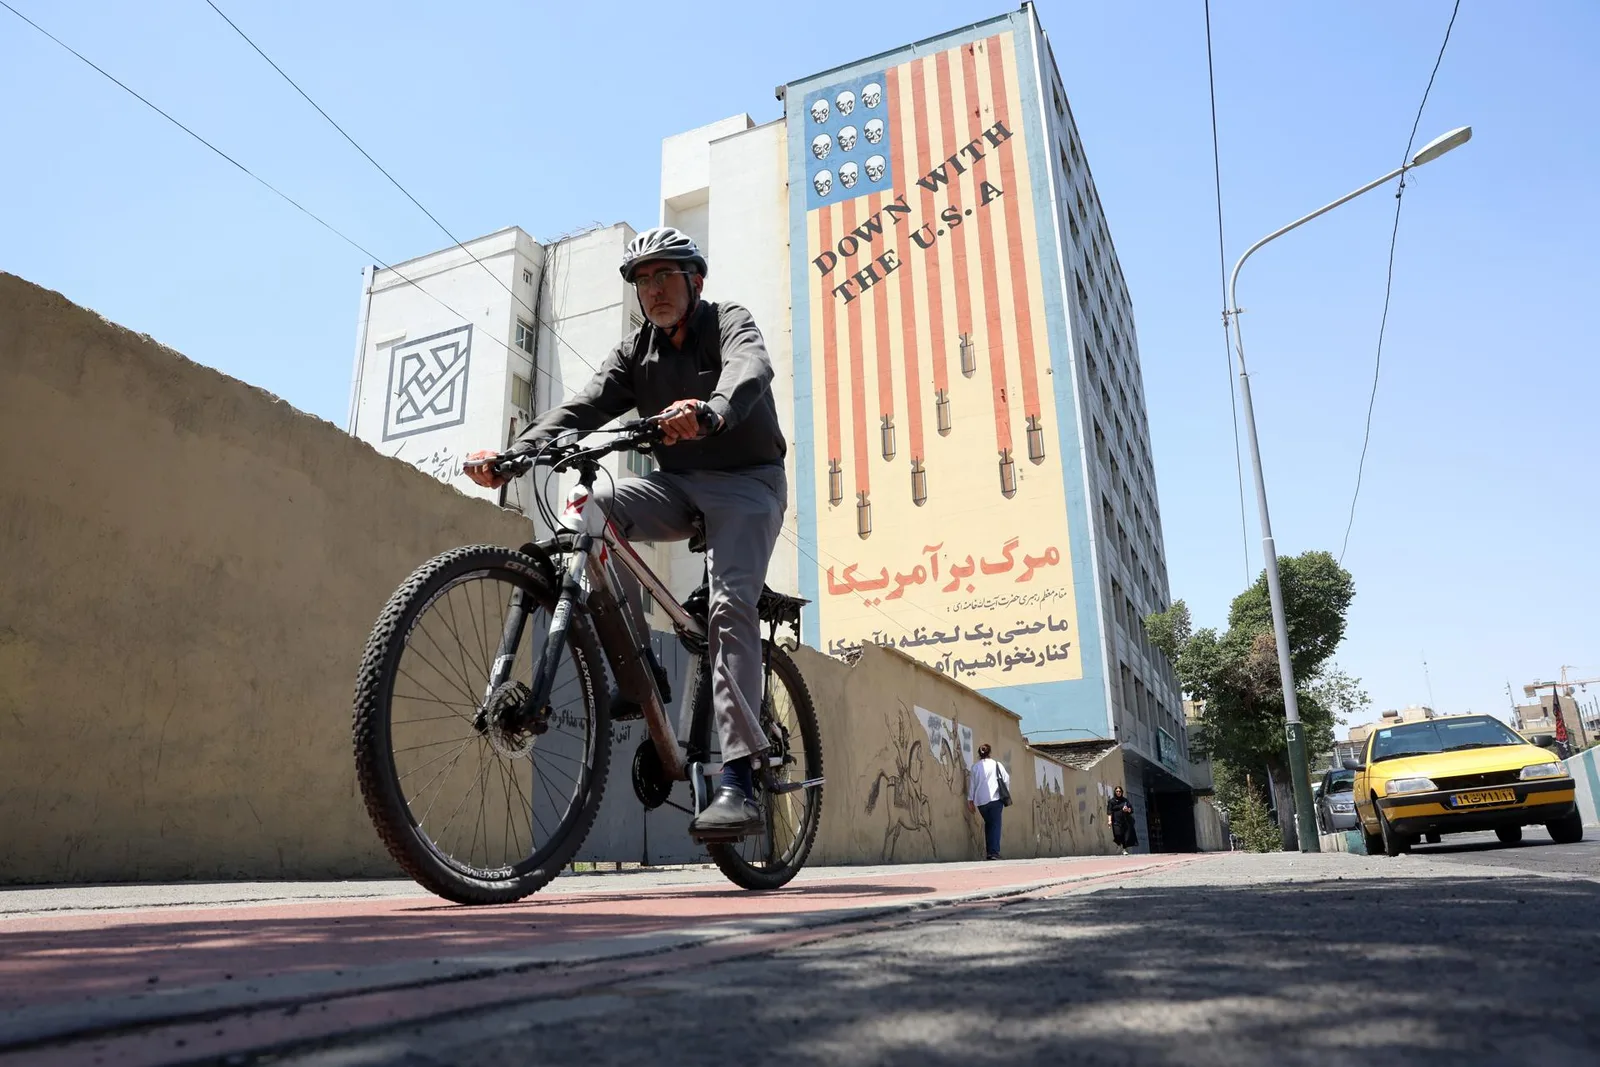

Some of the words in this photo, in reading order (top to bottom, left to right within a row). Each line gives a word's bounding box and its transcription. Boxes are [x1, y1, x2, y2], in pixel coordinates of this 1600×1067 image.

[812, 194, 912, 277] DOWN
[916, 120, 1014, 193] WITH
[832, 249, 902, 305] THE
[826, 541, 944, 608] آمریکا
[941, 554, 975, 594] بر
[979, 536, 1061, 583] مرگ
[899, 624, 961, 649] لحظه
[965, 623, 994, 646] یک
[997, 619, 1046, 643] حتی
[1048, 614, 1069, 632] ما
[953, 645, 1037, 679] نخواهیم
[1035, 642, 1071, 669] کنار
[575, 647, 595, 708] ALEXRIMS
[460, 865, 513, 879] ALEXRIMS
